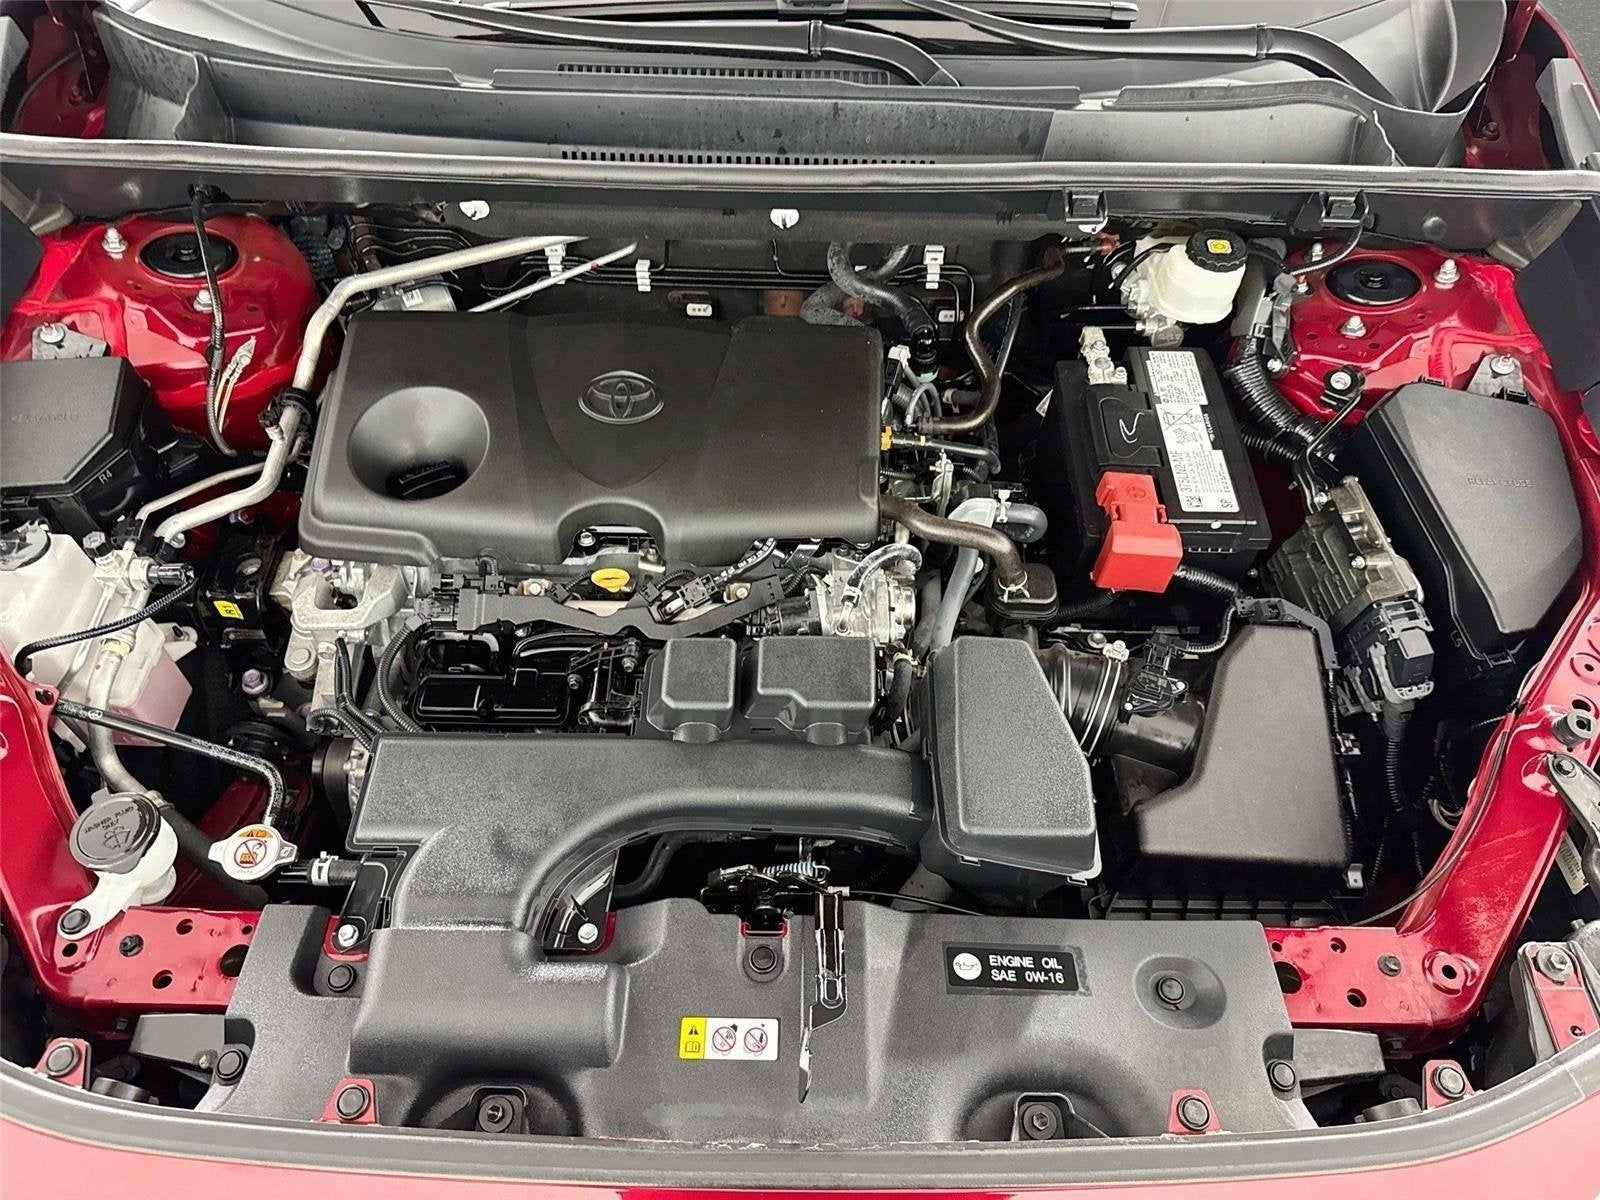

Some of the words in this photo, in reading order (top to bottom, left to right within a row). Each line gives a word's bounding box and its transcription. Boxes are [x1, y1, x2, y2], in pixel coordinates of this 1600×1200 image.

[99, 470, 113, 484] R4
[988, 955, 1034, 968] ENGINE
[1041, 957, 1063, 970] OIL
[991, 969, 1017, 981] SAE
[1025, 972, 1064, 984] 0W-16
